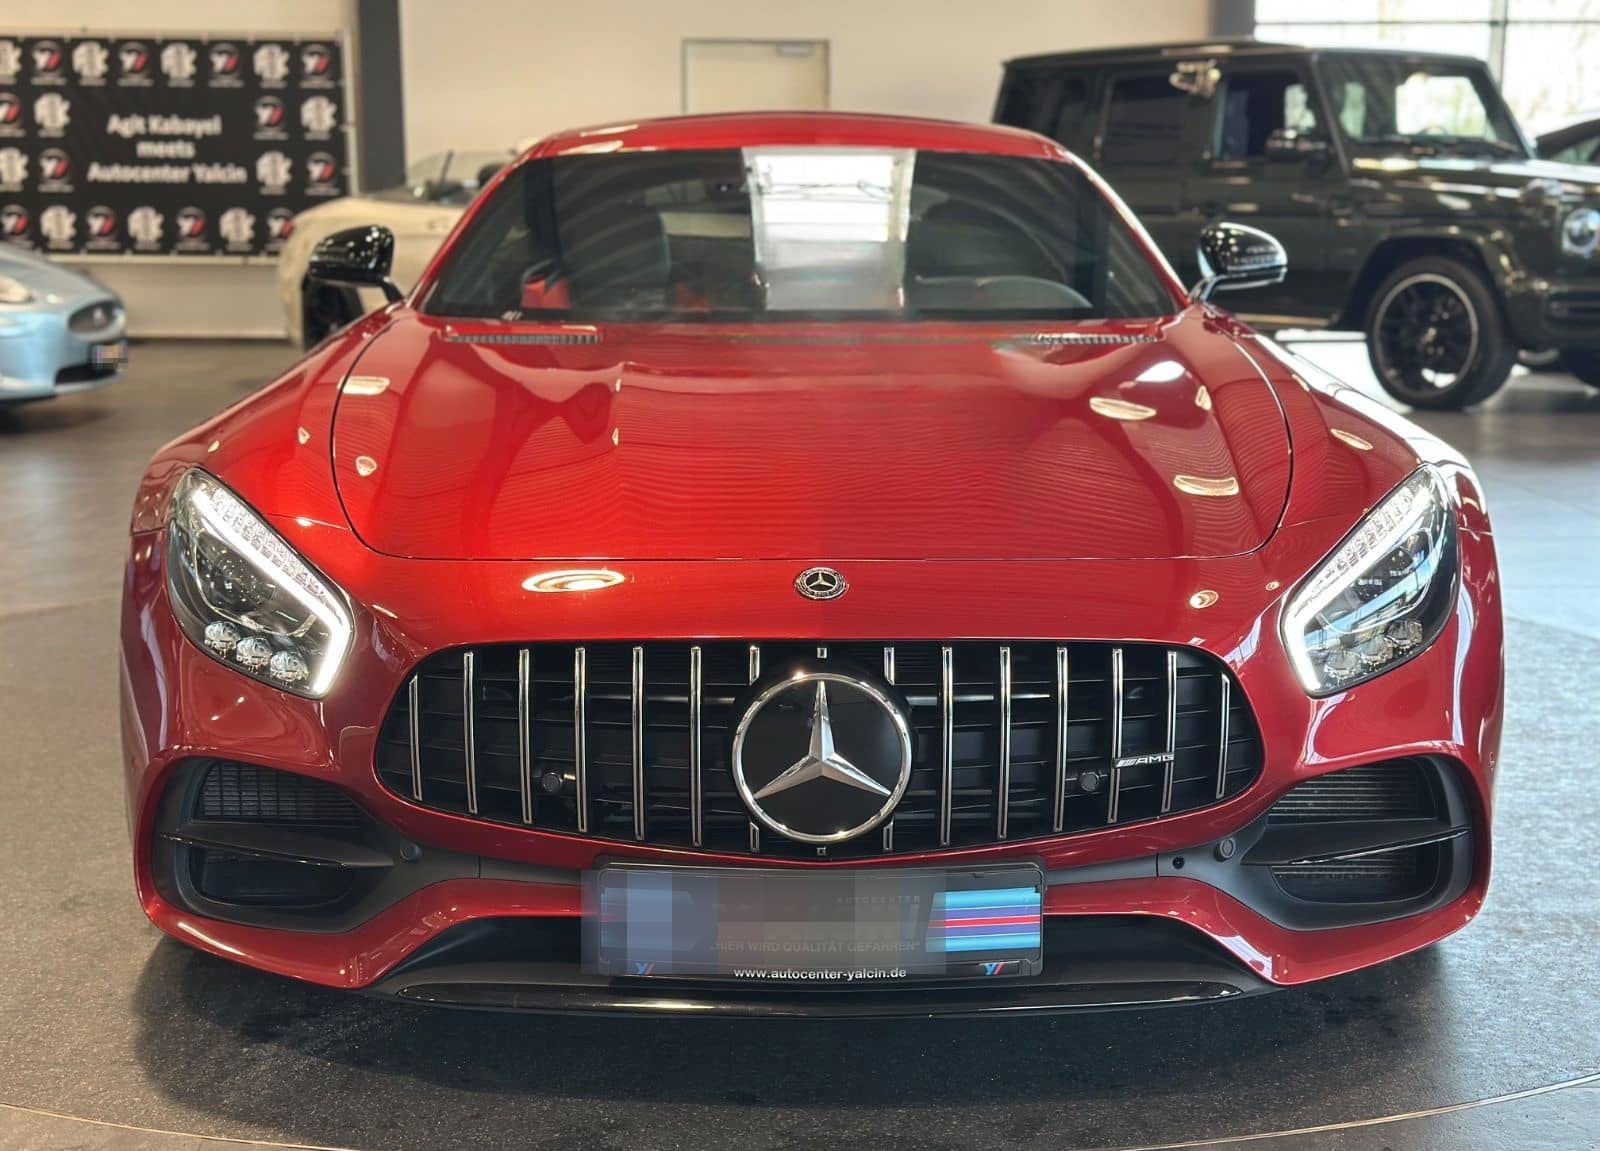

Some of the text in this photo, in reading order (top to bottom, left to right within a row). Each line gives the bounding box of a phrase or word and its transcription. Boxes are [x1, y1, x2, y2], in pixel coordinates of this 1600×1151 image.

[136, 140, 196, 159] meets
[87, 162, 190, 183] Autocenter
[1135, 754, 1174, 765] AMG
[749, 942, 780, 952] WIRD
[733, 967, 907, 982] www.autocenter-yalcin.de
